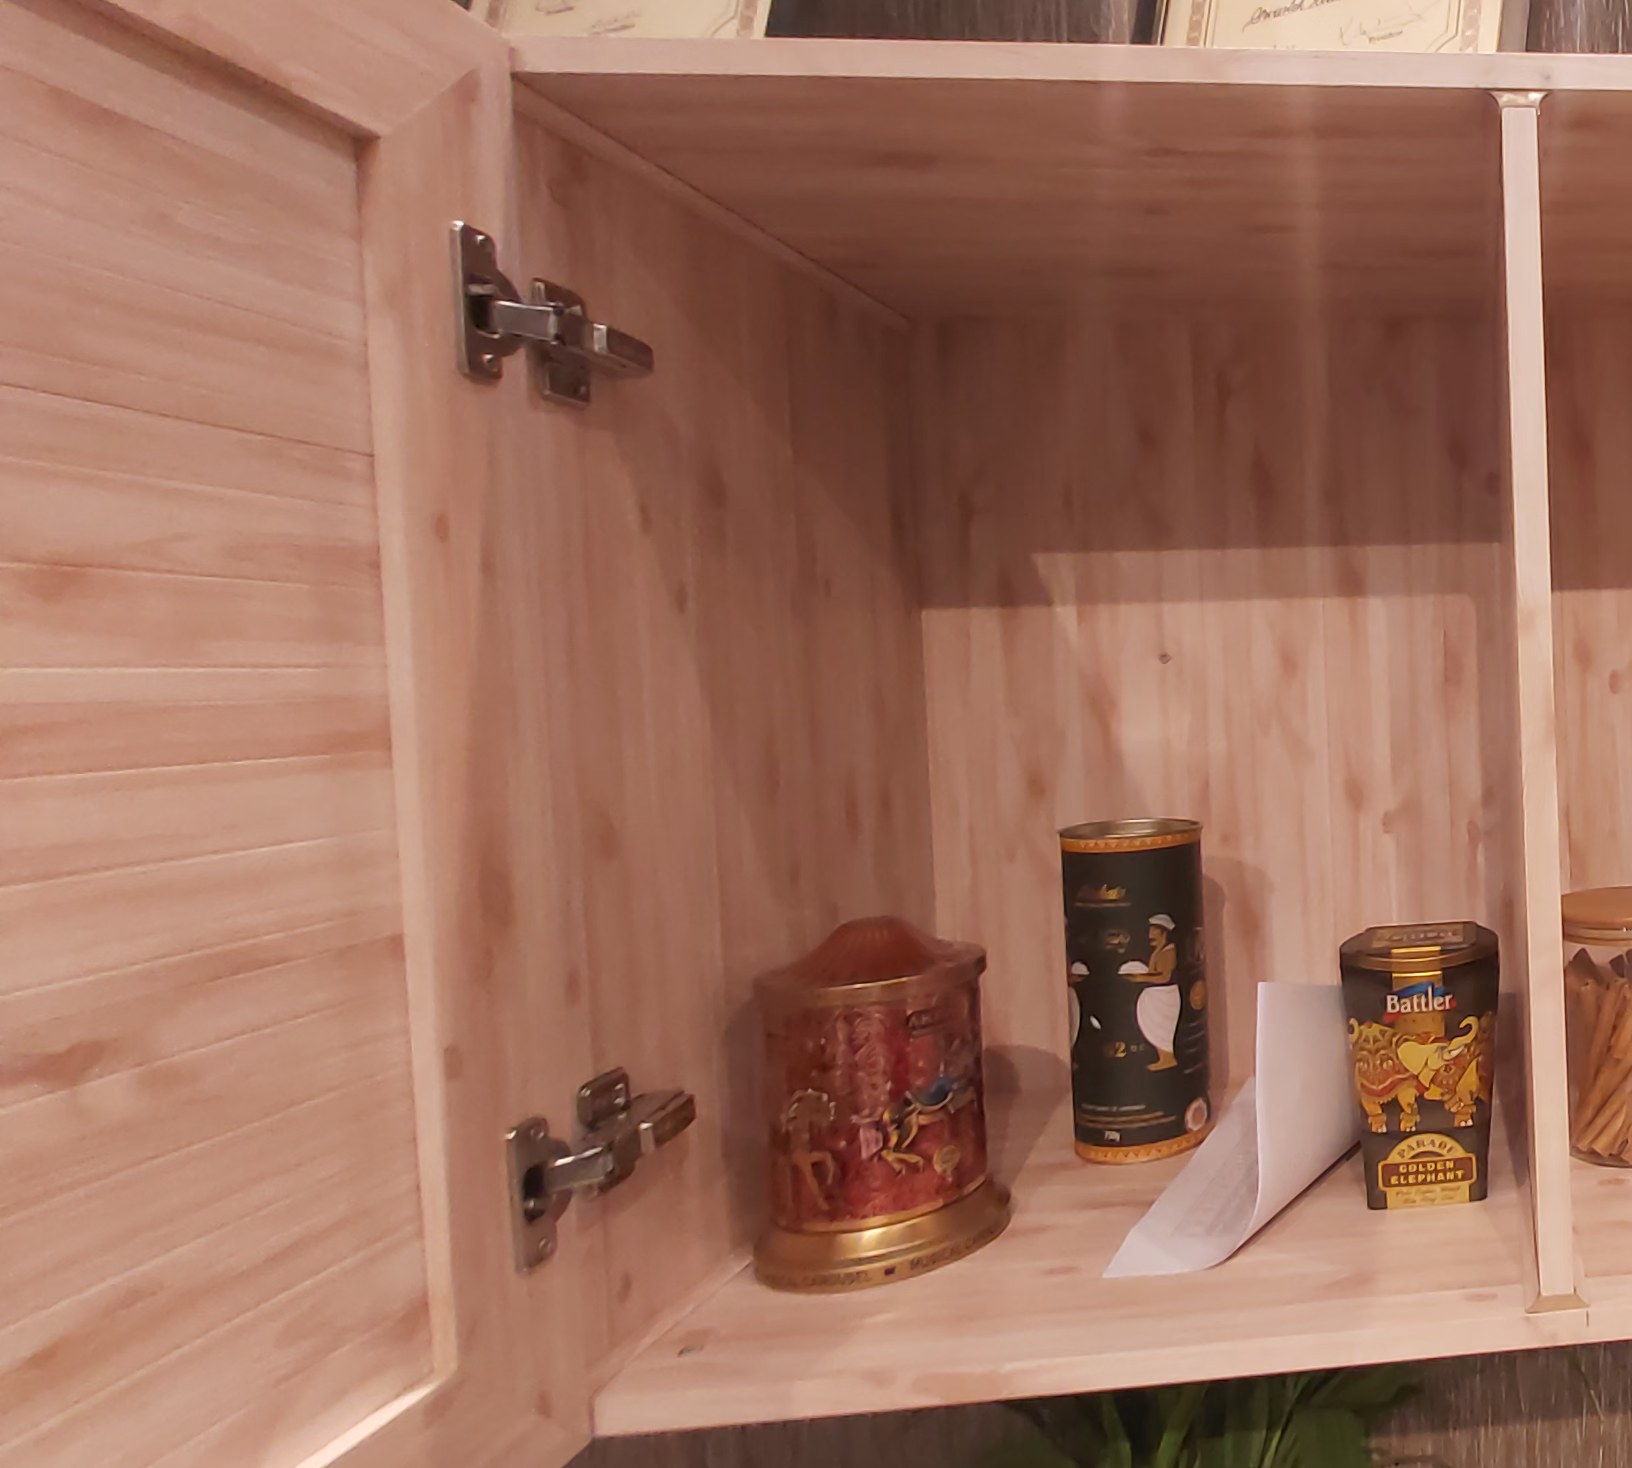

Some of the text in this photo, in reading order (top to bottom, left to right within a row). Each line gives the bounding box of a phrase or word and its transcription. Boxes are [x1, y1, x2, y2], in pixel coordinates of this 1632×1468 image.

[1386, 992, 1453, 1014] Battler
[1397, 1138, 1456, 1159] PARADE
[1399, 1160, 1454, 1173] GOLDEN
[1390, 1169, 1465, 1185] ELEPHANT
